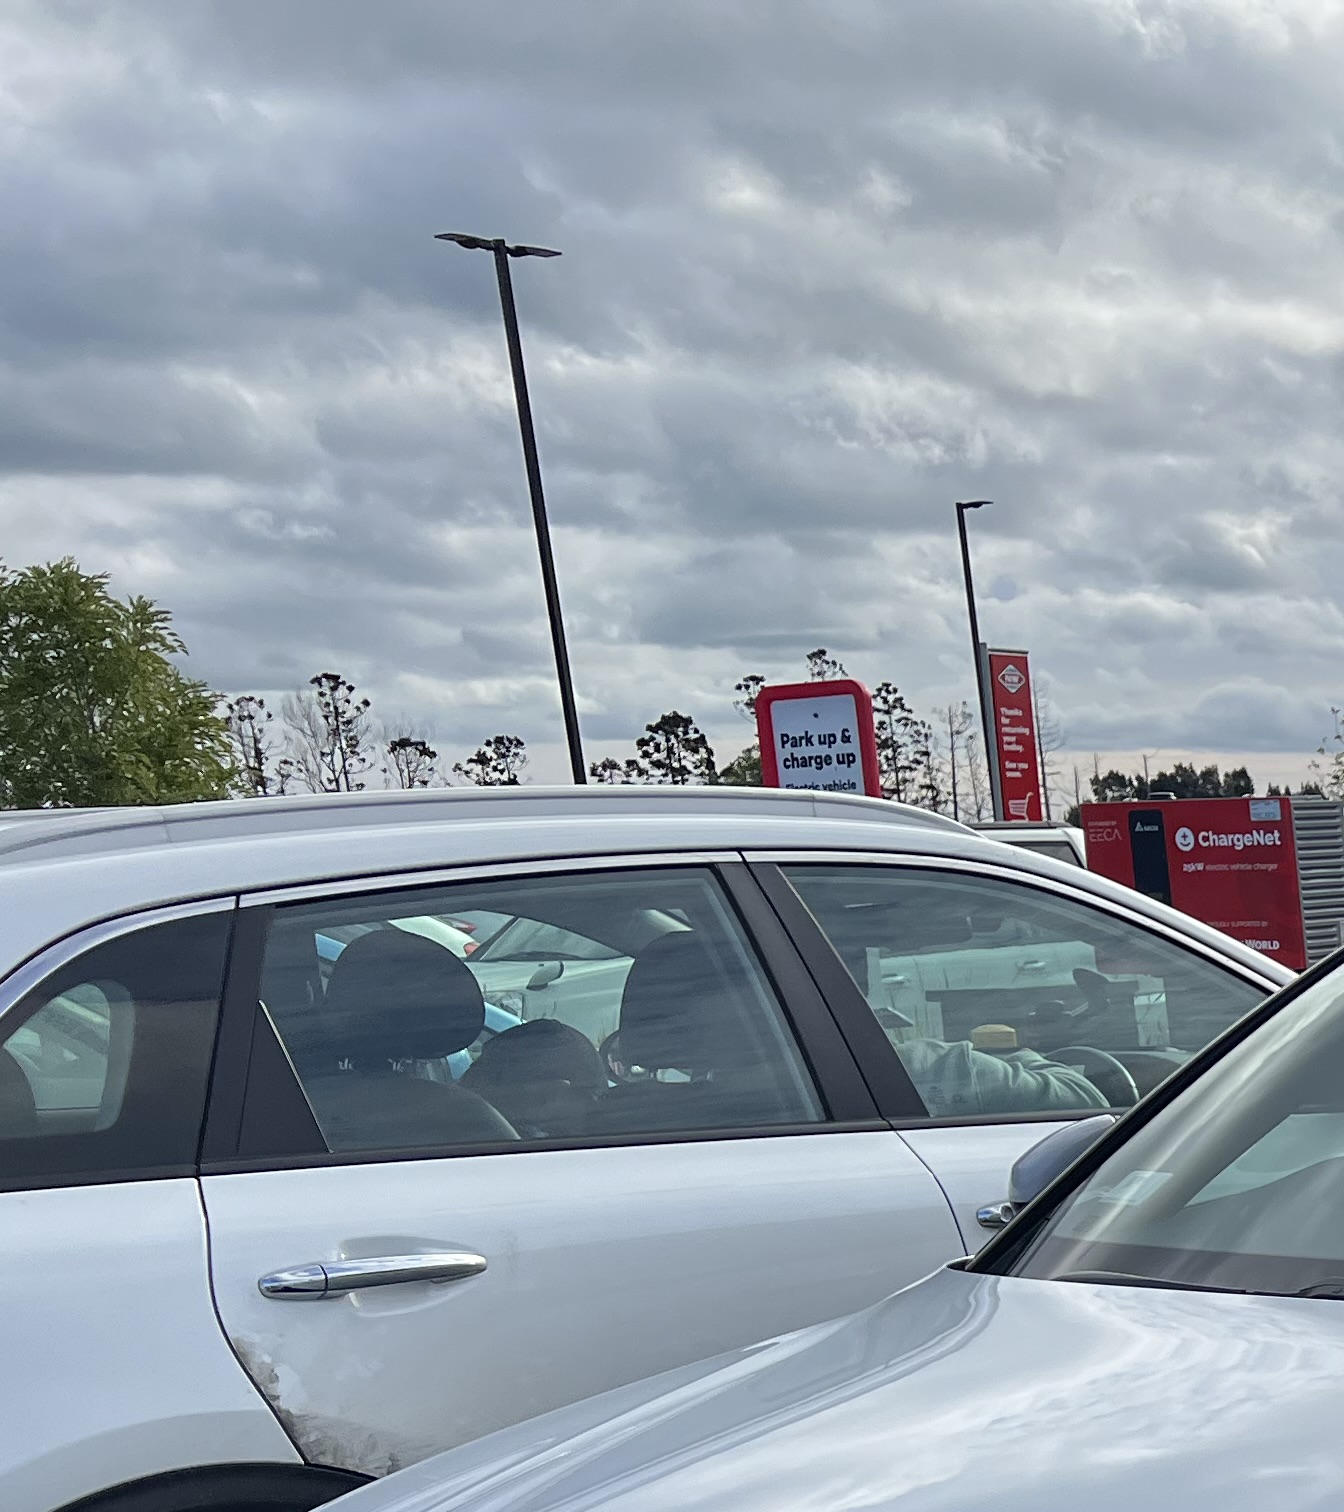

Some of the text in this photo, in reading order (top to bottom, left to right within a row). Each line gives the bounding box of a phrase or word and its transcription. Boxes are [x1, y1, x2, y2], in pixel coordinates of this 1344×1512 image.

[780, 728, 852, 749] Park up &
[783, 752, 857, 771] charge up
[1198, 830, 1281, 851] ChargeNet
